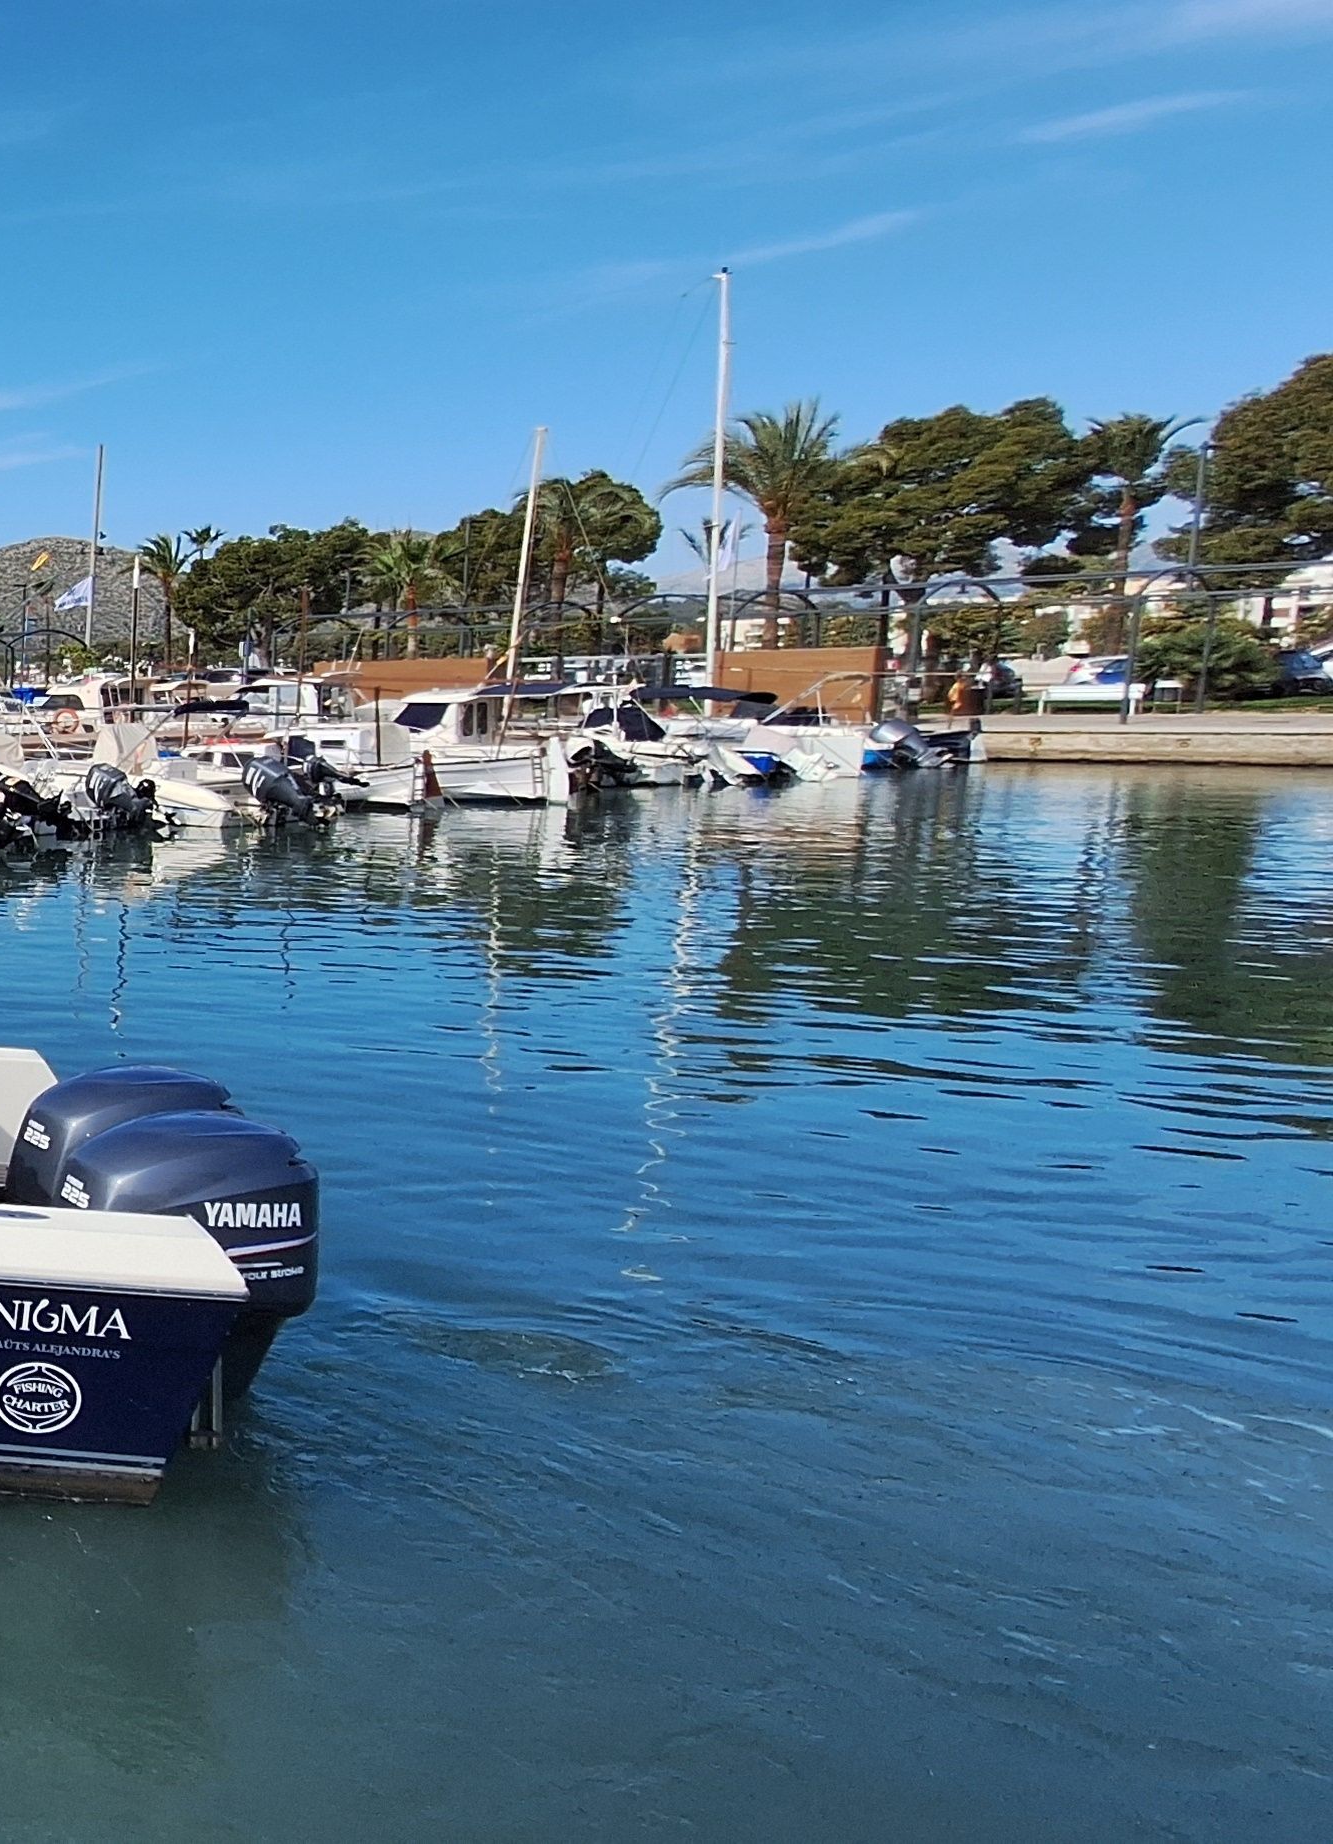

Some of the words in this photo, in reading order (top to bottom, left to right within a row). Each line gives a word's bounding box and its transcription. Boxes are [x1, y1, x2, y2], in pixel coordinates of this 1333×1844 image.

[23, 1126, 51, 1150] 225
[60, 1181, 90, 1209] 225
[203, 1201, 302, 1229] YAMAHA
[32, 1343, 121, 1360] ALEJANDRA'S
[13, 1381, 65, 1399] FISHING
[1, 1394, 72, 1413] CHARTER
